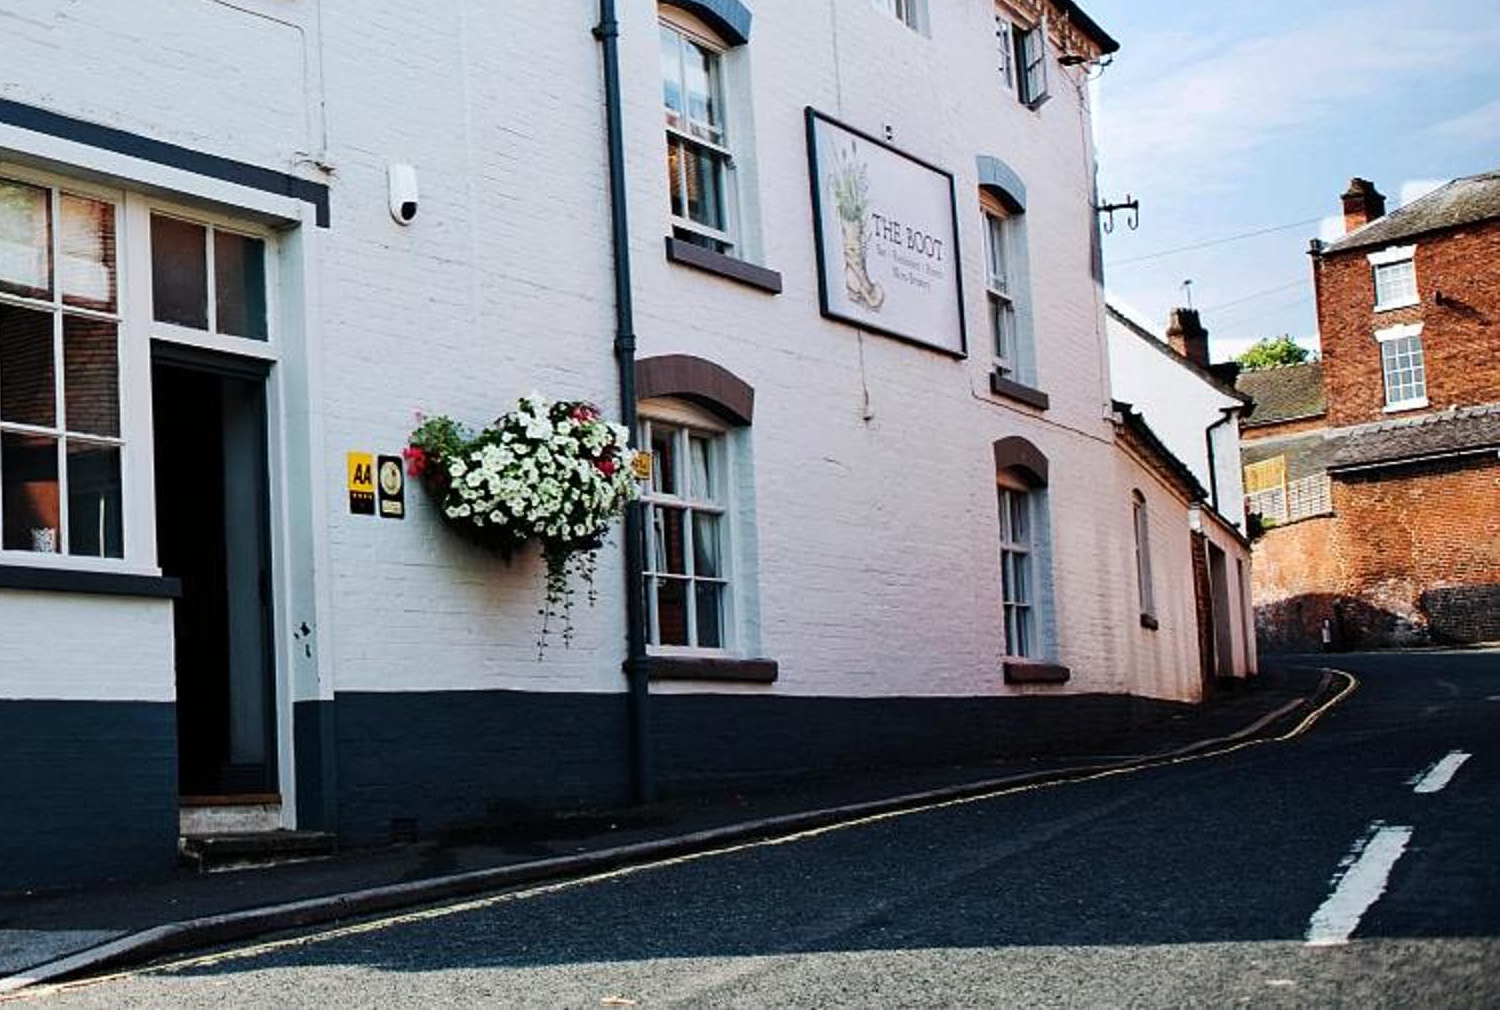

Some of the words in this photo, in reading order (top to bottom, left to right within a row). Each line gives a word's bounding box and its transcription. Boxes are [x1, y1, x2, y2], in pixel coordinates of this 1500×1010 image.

[872, 213, 901, 245] THE
[906, 227, 943, 261] BOOT
[353, 463, 372, 485] AA
